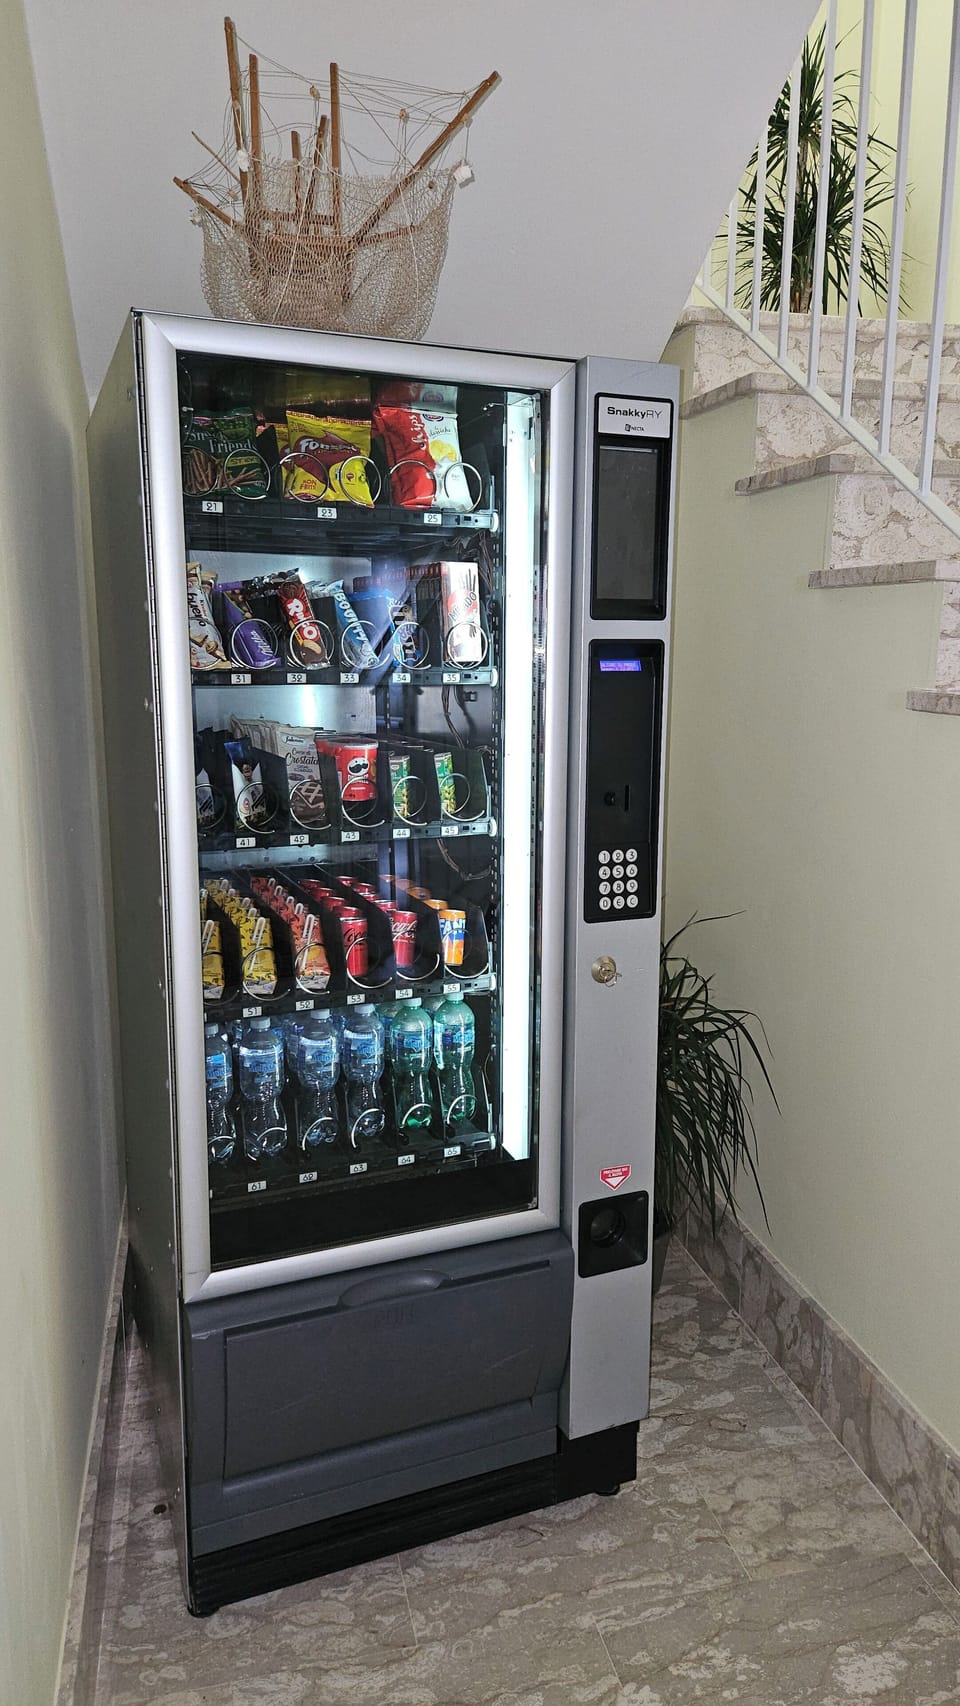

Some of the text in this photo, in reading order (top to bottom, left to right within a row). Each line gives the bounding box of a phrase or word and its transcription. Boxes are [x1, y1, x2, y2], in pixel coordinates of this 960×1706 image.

[607, 406, 662, 419] SnakkyRY
[206, 502, 217, 511] 21
[321, 509, 333, 517] 23
[427, 514, 439, 522] 25
[235, 675, 246, 683] 31
[291, 674, 303, 682] 32
[344, 674, 355, 682] 33
[446, 674, 457, 682] 35
[294, 835, 305, 843] 42
[399, 989, 409, 997] 54
[351, 994, 362, 1002] 53
[300, 1001, 311, 1009] 52
[247, 1007, 258, 1015] 51
[447, 1147, 458, 1155] 65
[400, 1156, 412, 1164] 64
[353, 1164, 364, 1172] 63
[302, 1173, 314, 1182] 62
[251, 1182, 262, 1191] 61
